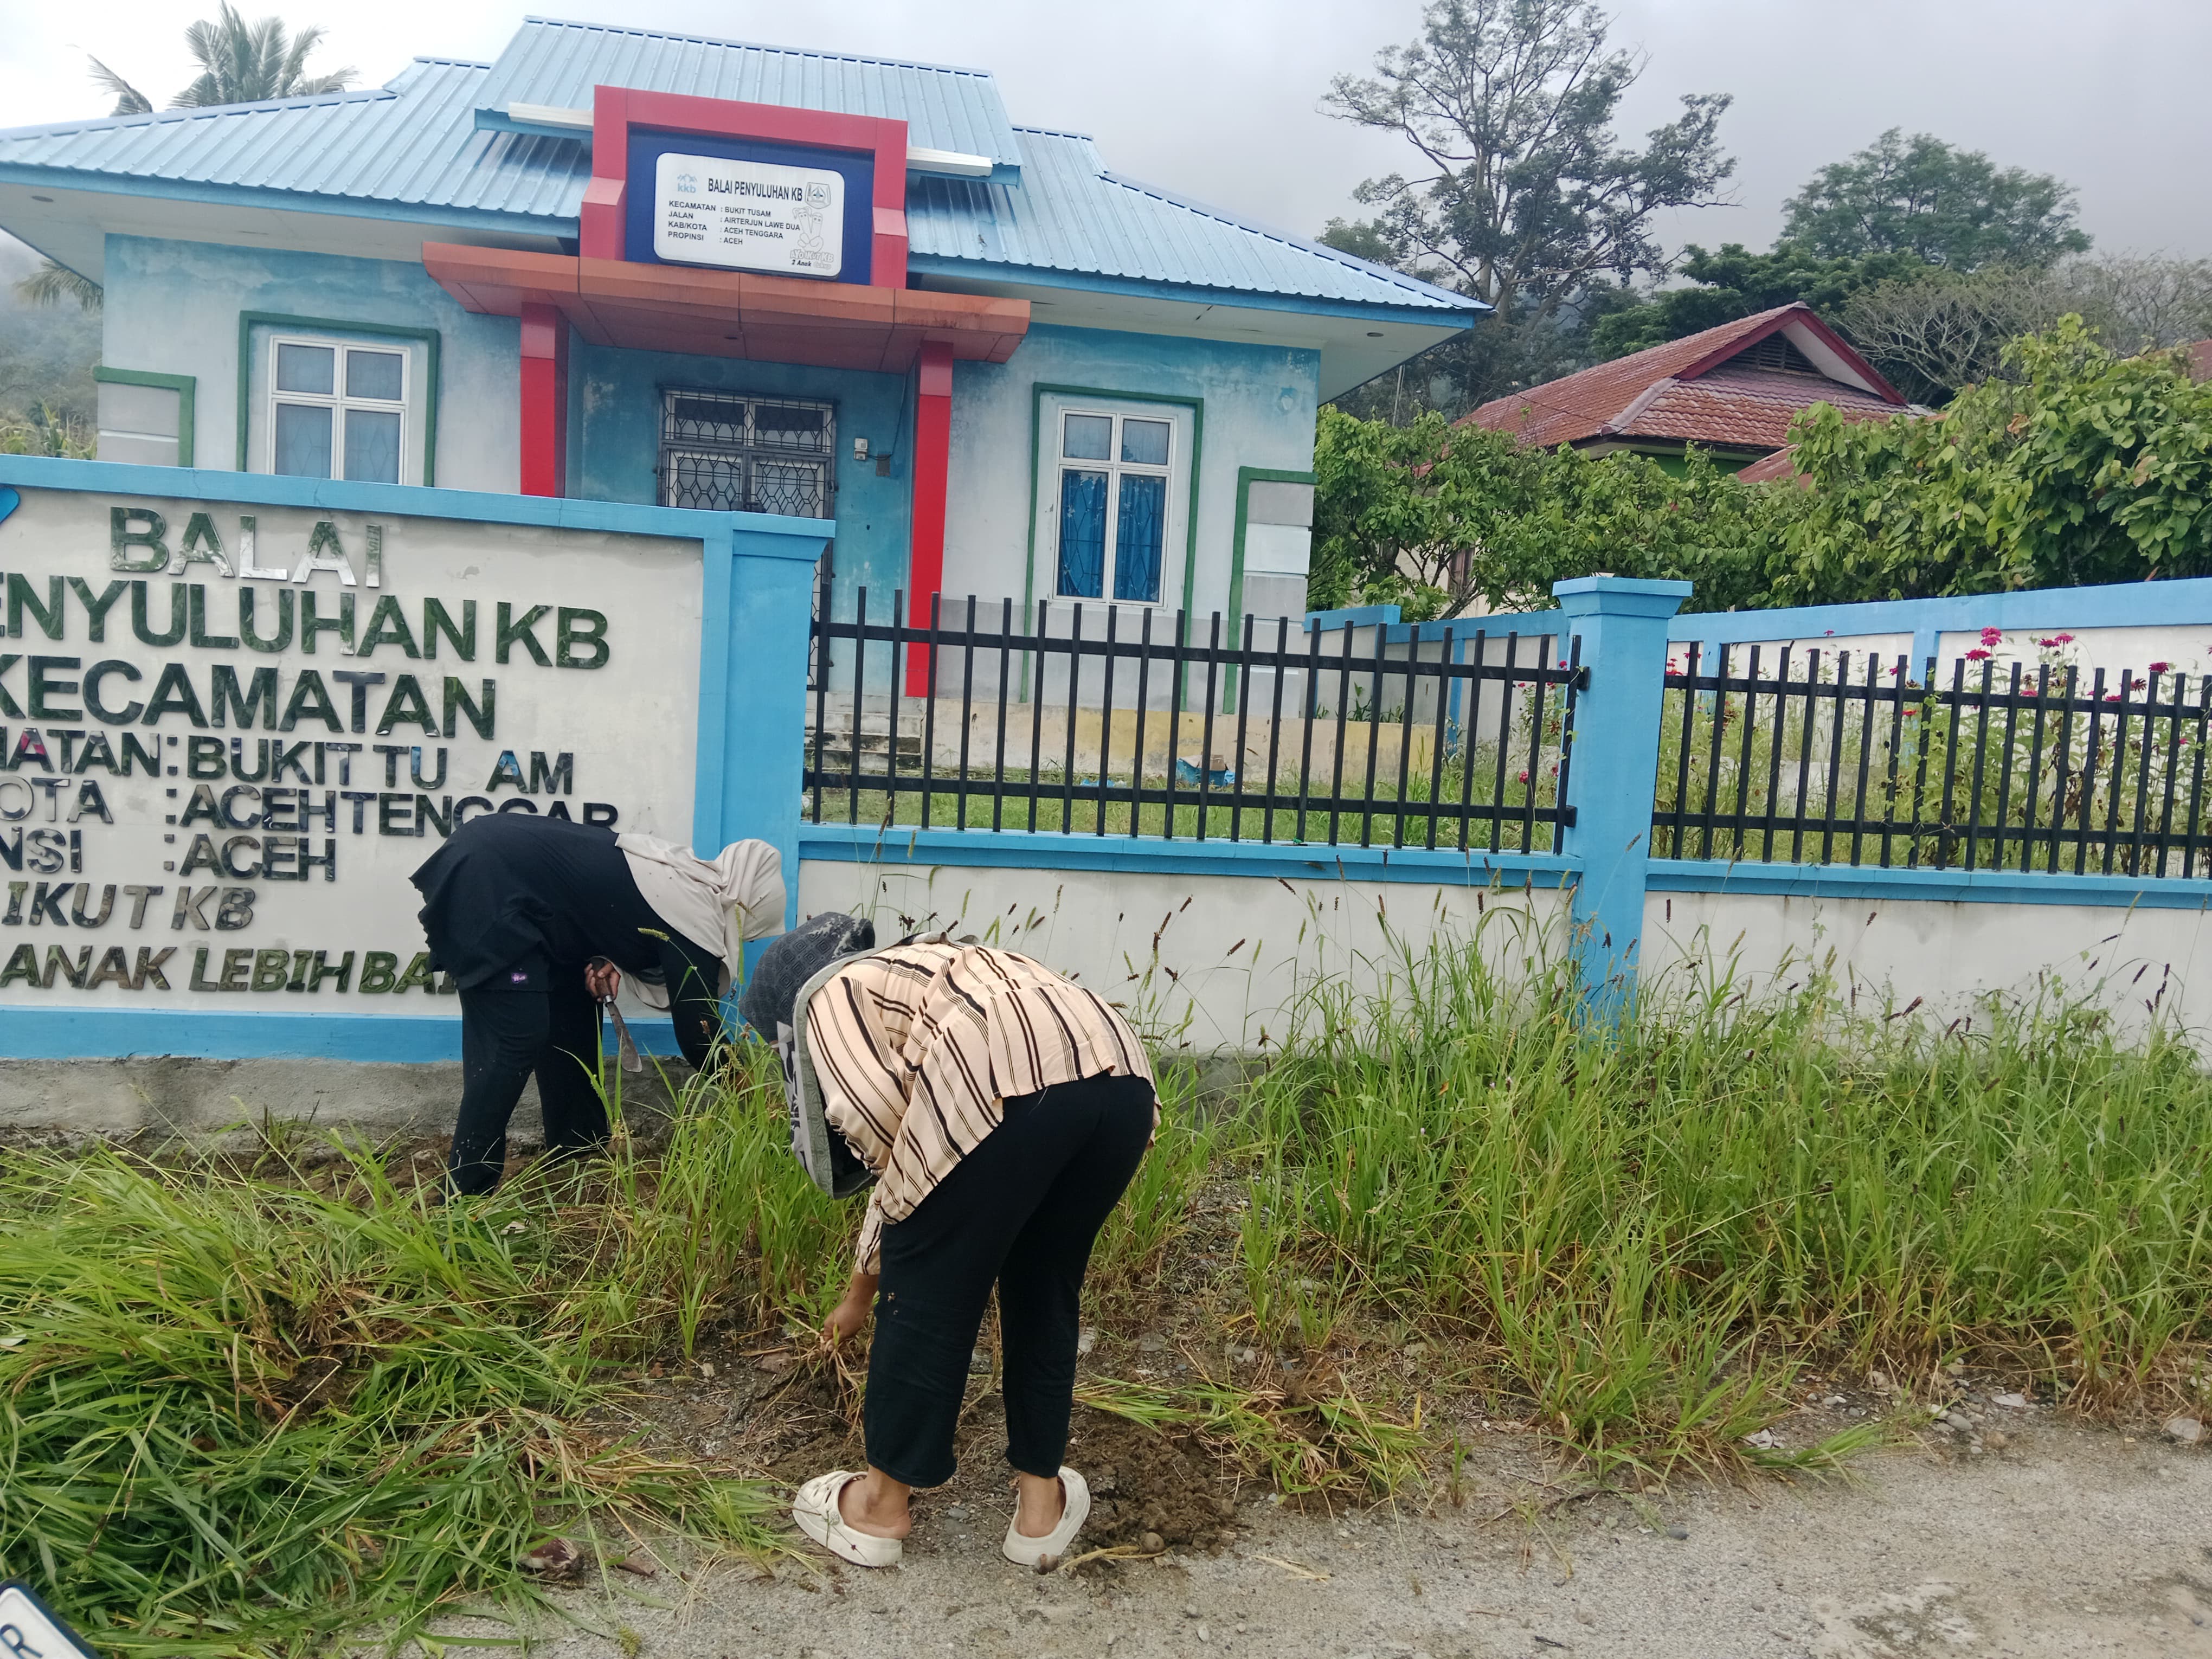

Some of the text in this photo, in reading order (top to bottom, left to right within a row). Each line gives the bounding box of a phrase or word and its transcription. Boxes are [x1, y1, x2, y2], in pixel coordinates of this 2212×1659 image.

[708, 178, 802, 201] BALAI PENYULUHAN KB
[668, 200, 716, 211] KECAMATAN
[725, 206, 745, 214] BUKIT
[748, 209, 771, 217] TUSAM
[668, 210, 693, 219] JALAN
[724, 217, 763, 227] AIRTERJUN
[668, 221, 707, 231] KAB/KOTA
[724, 227, 743, 235] ACEH
[745, 229, 783, 239] TENGGARA
[668, 231, 704, 241] PROPINSI
[821, 252, 833, 262] KB
[110, 506, 381, 588] BALAI
[0, 572, 610, 669] NYULUHAN KB
[0, 726, 160, 777] ATAN
[0, 776, 114, 824] OTA
[2, 881, 255, 930] IKUT KB
[0, 944, 177, 991] ANAK
[189, 948, 355, 993] LEBIH
